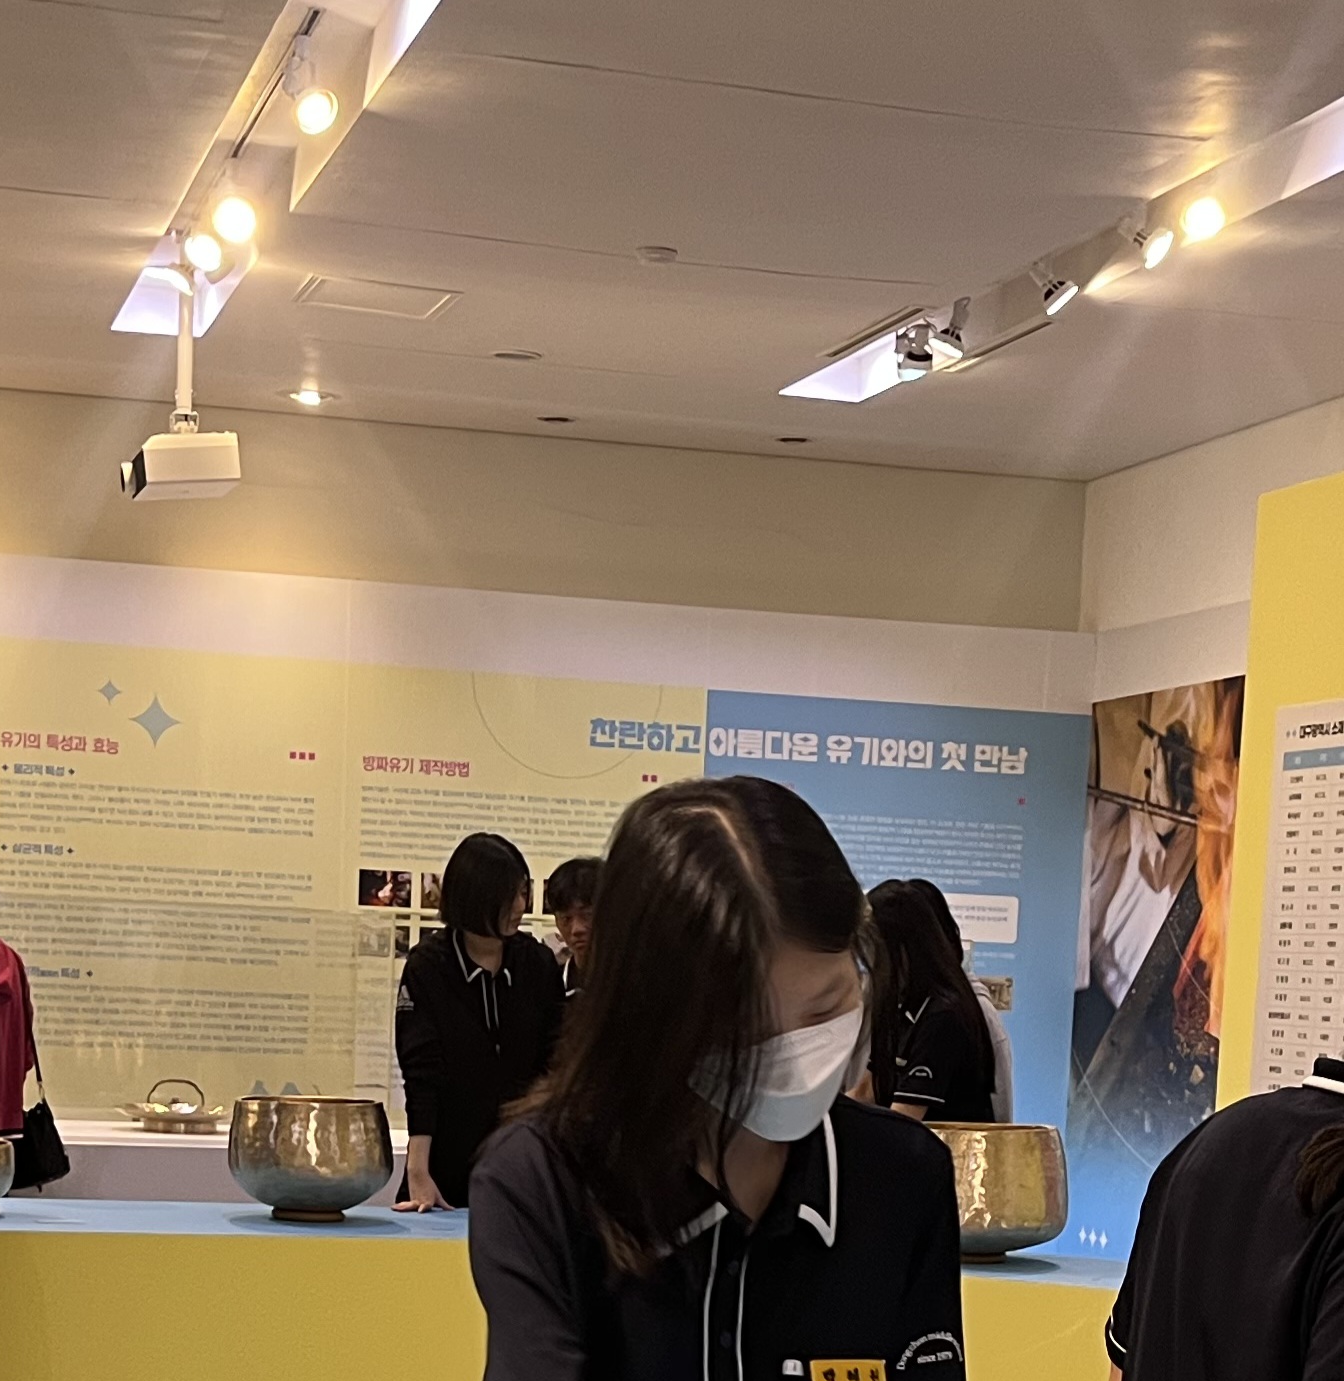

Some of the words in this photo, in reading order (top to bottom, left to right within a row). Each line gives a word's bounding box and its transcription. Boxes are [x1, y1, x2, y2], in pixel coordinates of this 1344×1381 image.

[0, 731, 41, 749] 유기의
[46, 733, 87, 752] 특성과
[92, 737, 119, 755] 효능
[589, 717, 701, 754] 찬란하고
[708, 727, 818, 763] 아름다운
[825, 734, 933, 770] 유기와의
[941, 741, 967, 773] 첫
[972, 743, 1028, 776] 만남
[362, 756, 414, 775] 방짜유기
[418, 758, 471, 778] 제작방법
